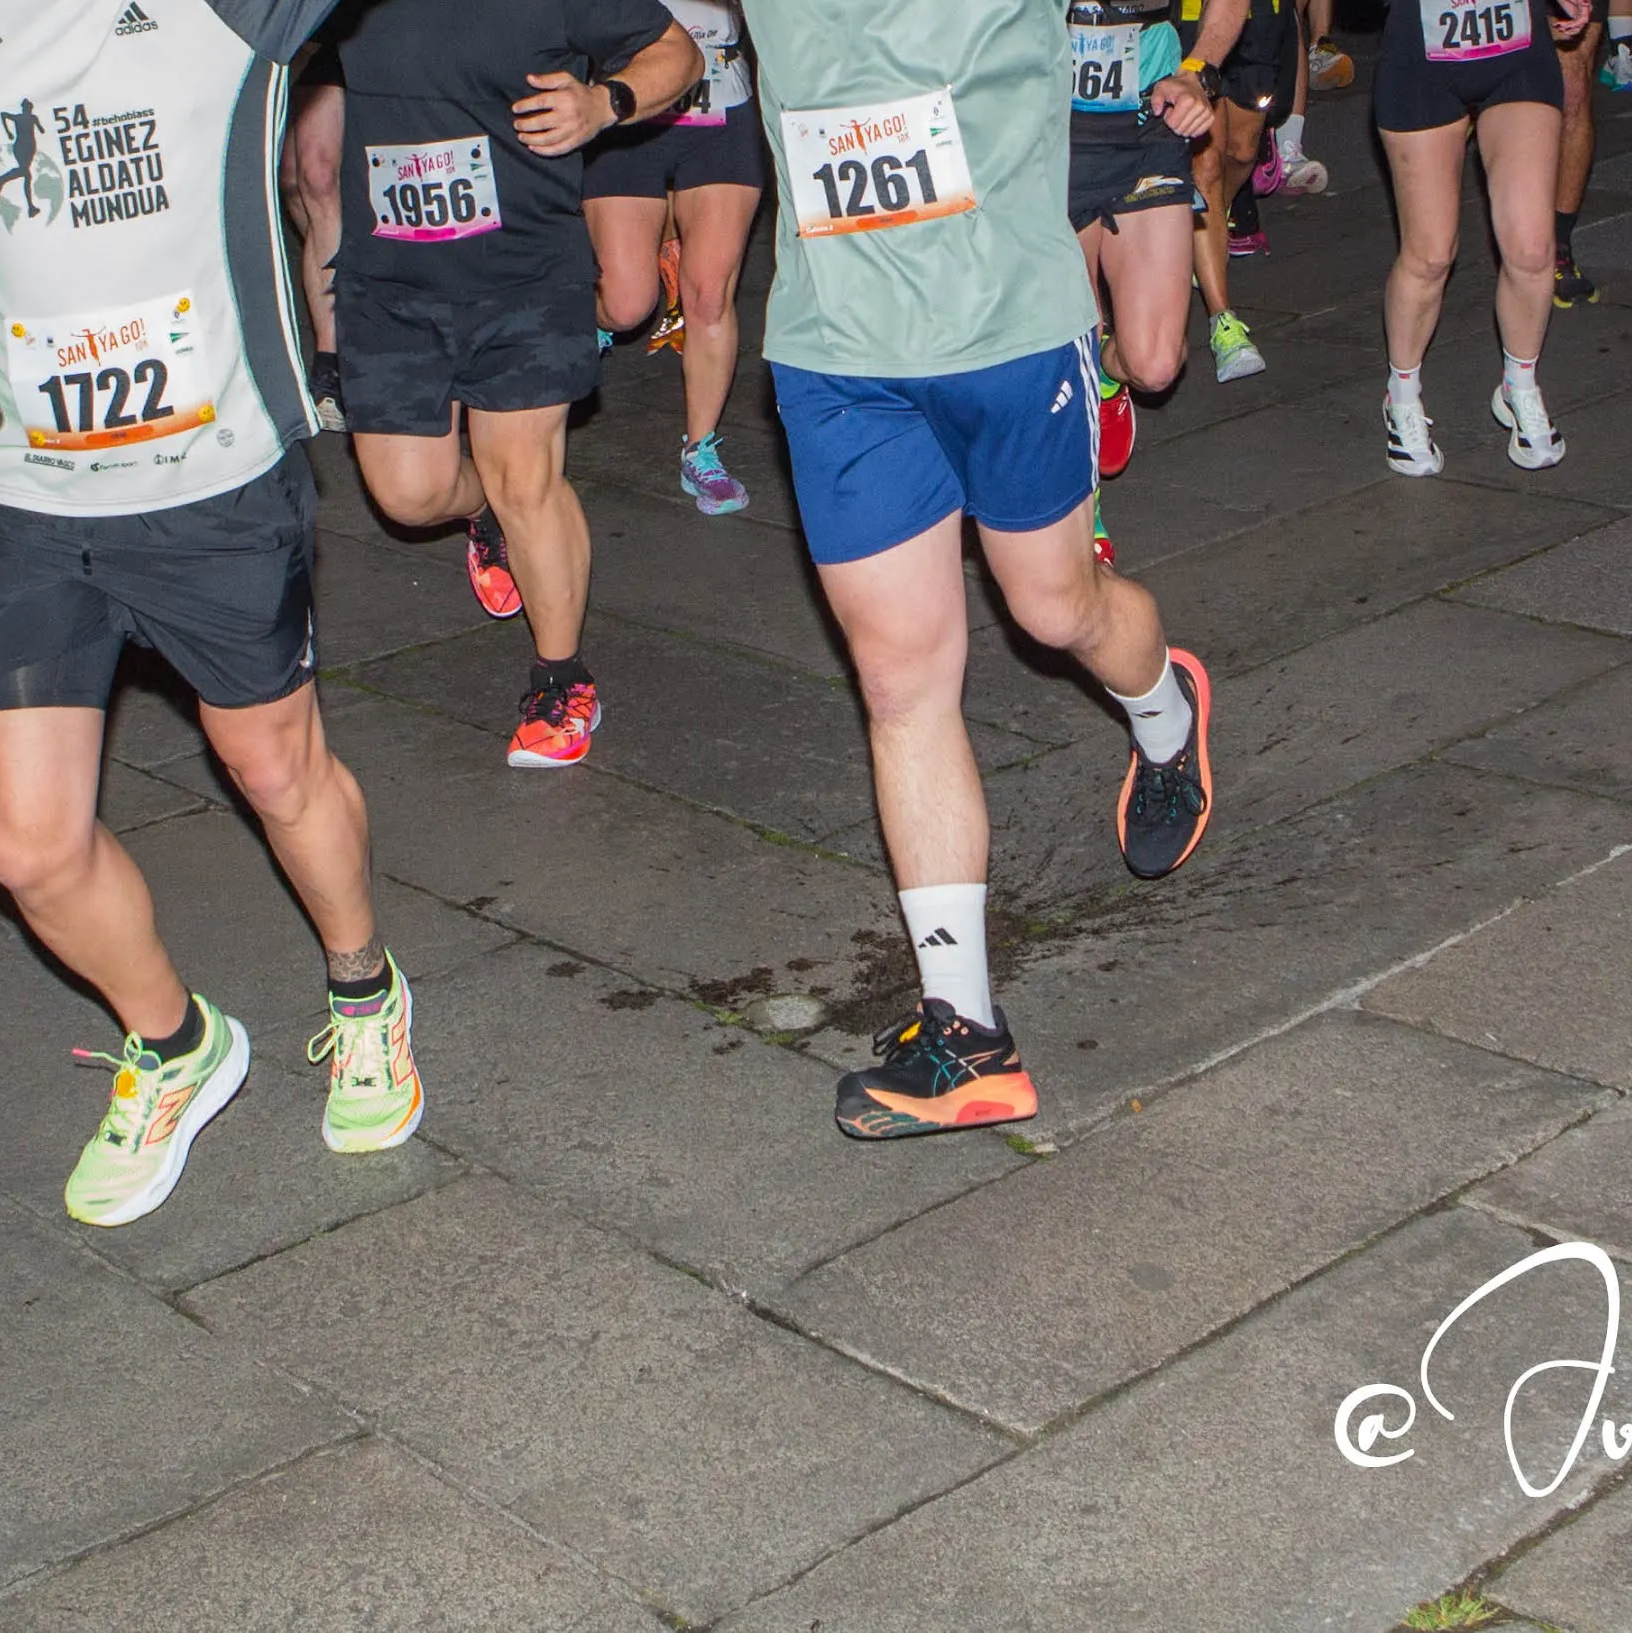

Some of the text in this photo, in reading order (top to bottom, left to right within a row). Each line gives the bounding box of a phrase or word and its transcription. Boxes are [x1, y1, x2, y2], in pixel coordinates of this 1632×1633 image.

[115, 19, 159, 37] adidas
[1439, 2, 1514, 51] 2415
[52, 104, 89, 135] 54
[58, 119, 161, 167] EGINEZ
[67, 152, 164, 200] ALDATU
[813, 148, 939, 219] 1261
[70, 184, 170, 229] MUNDUA
[382, 177, 474, 228] 1956
[38, 358, 175, 434] 1722
